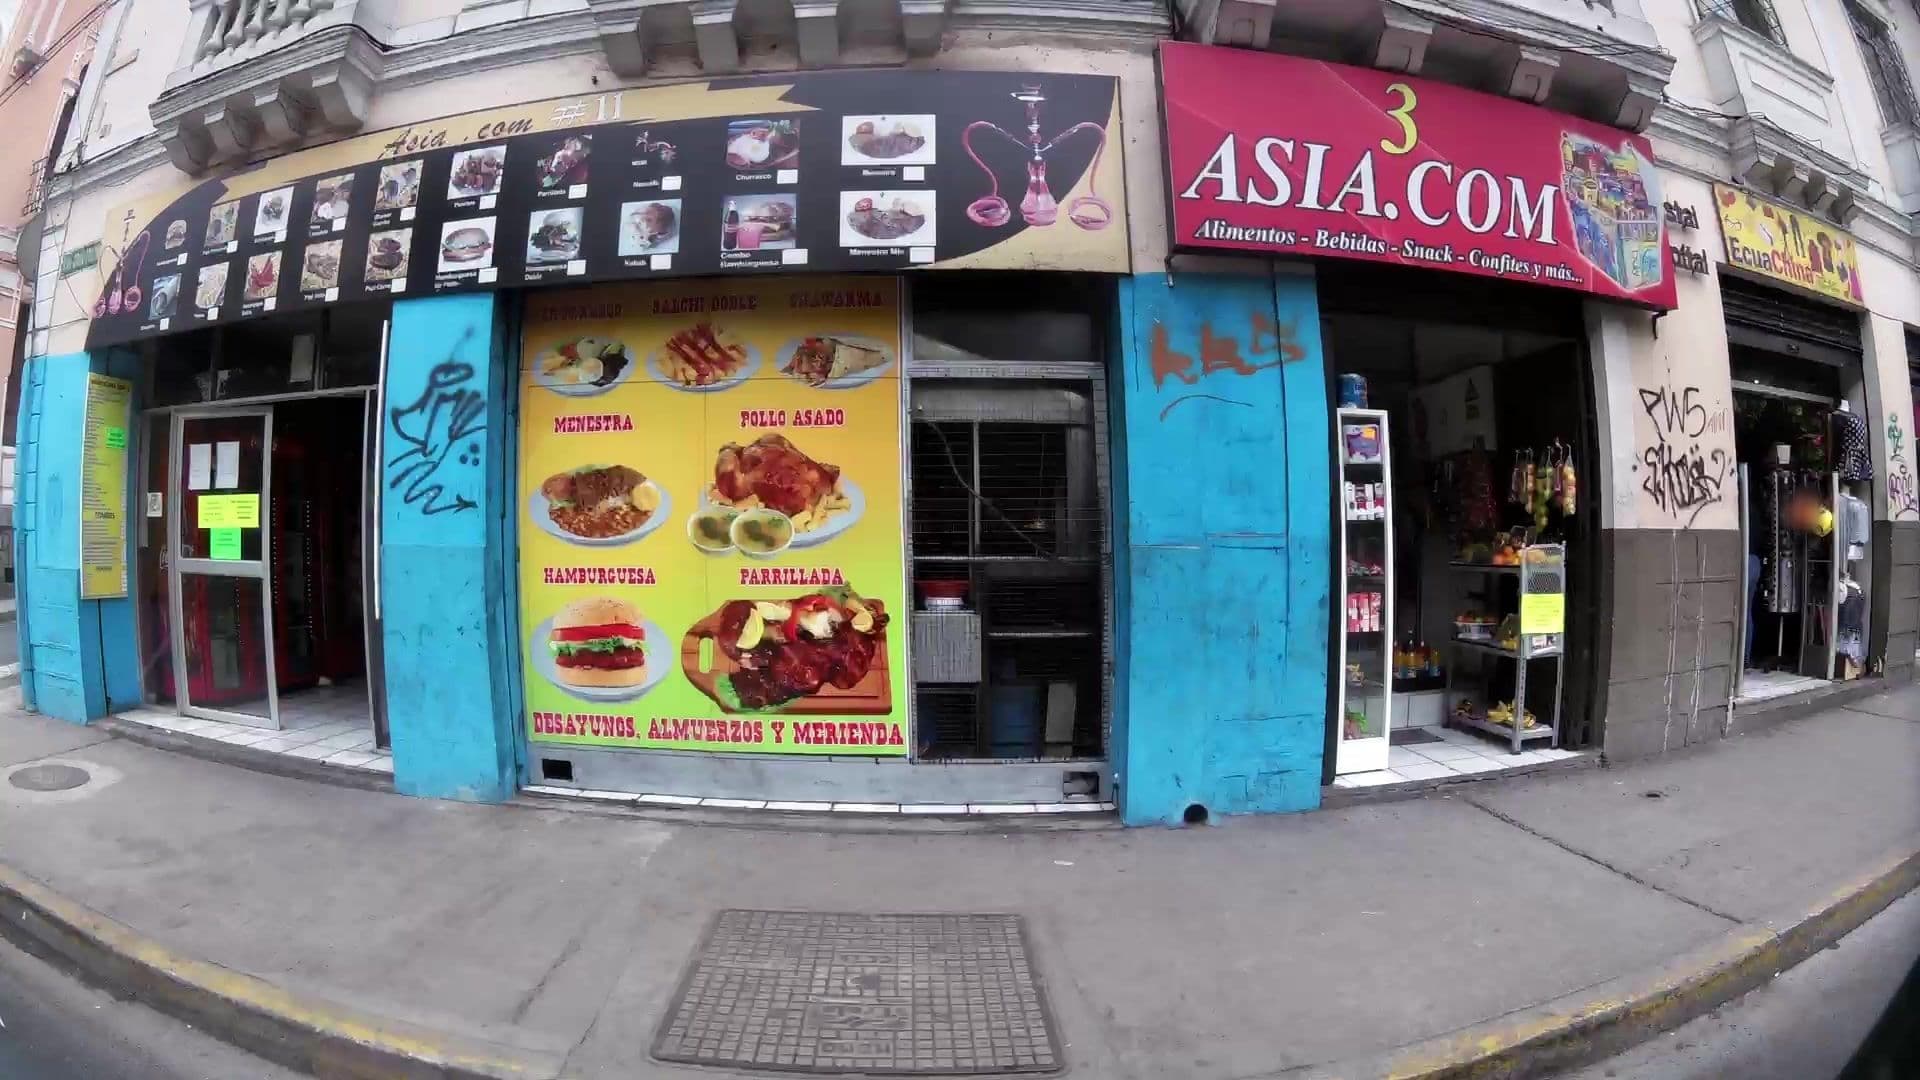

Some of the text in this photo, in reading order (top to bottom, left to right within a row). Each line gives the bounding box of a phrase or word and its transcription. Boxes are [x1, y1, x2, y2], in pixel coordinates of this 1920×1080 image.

[1379, 83, 1420, 156] 3
[735, 172, 772, 181] Churrasco
[1180, 133, 1560, 245] ASIA.COM
[1195, 219, 1296, 245] Alimentos
[1315, 229, 1386, 254] Bebidas
[1401, 239, 1453, 263] Snack
[1468, 248, 1529, 275] Confites
[1532, 263, 1542, 279] y
[554, 414, 633, 433] MENESTRA
[740, 408, 845, 428] POLLO ASADO
[543, 567, 656, 586] HAMBURGUESA
[740, 567, 844, 586] PARRILLADA
[532, 711, 905, 746] DESAYUNOS, ALMUERZOS Y MERIENDA
